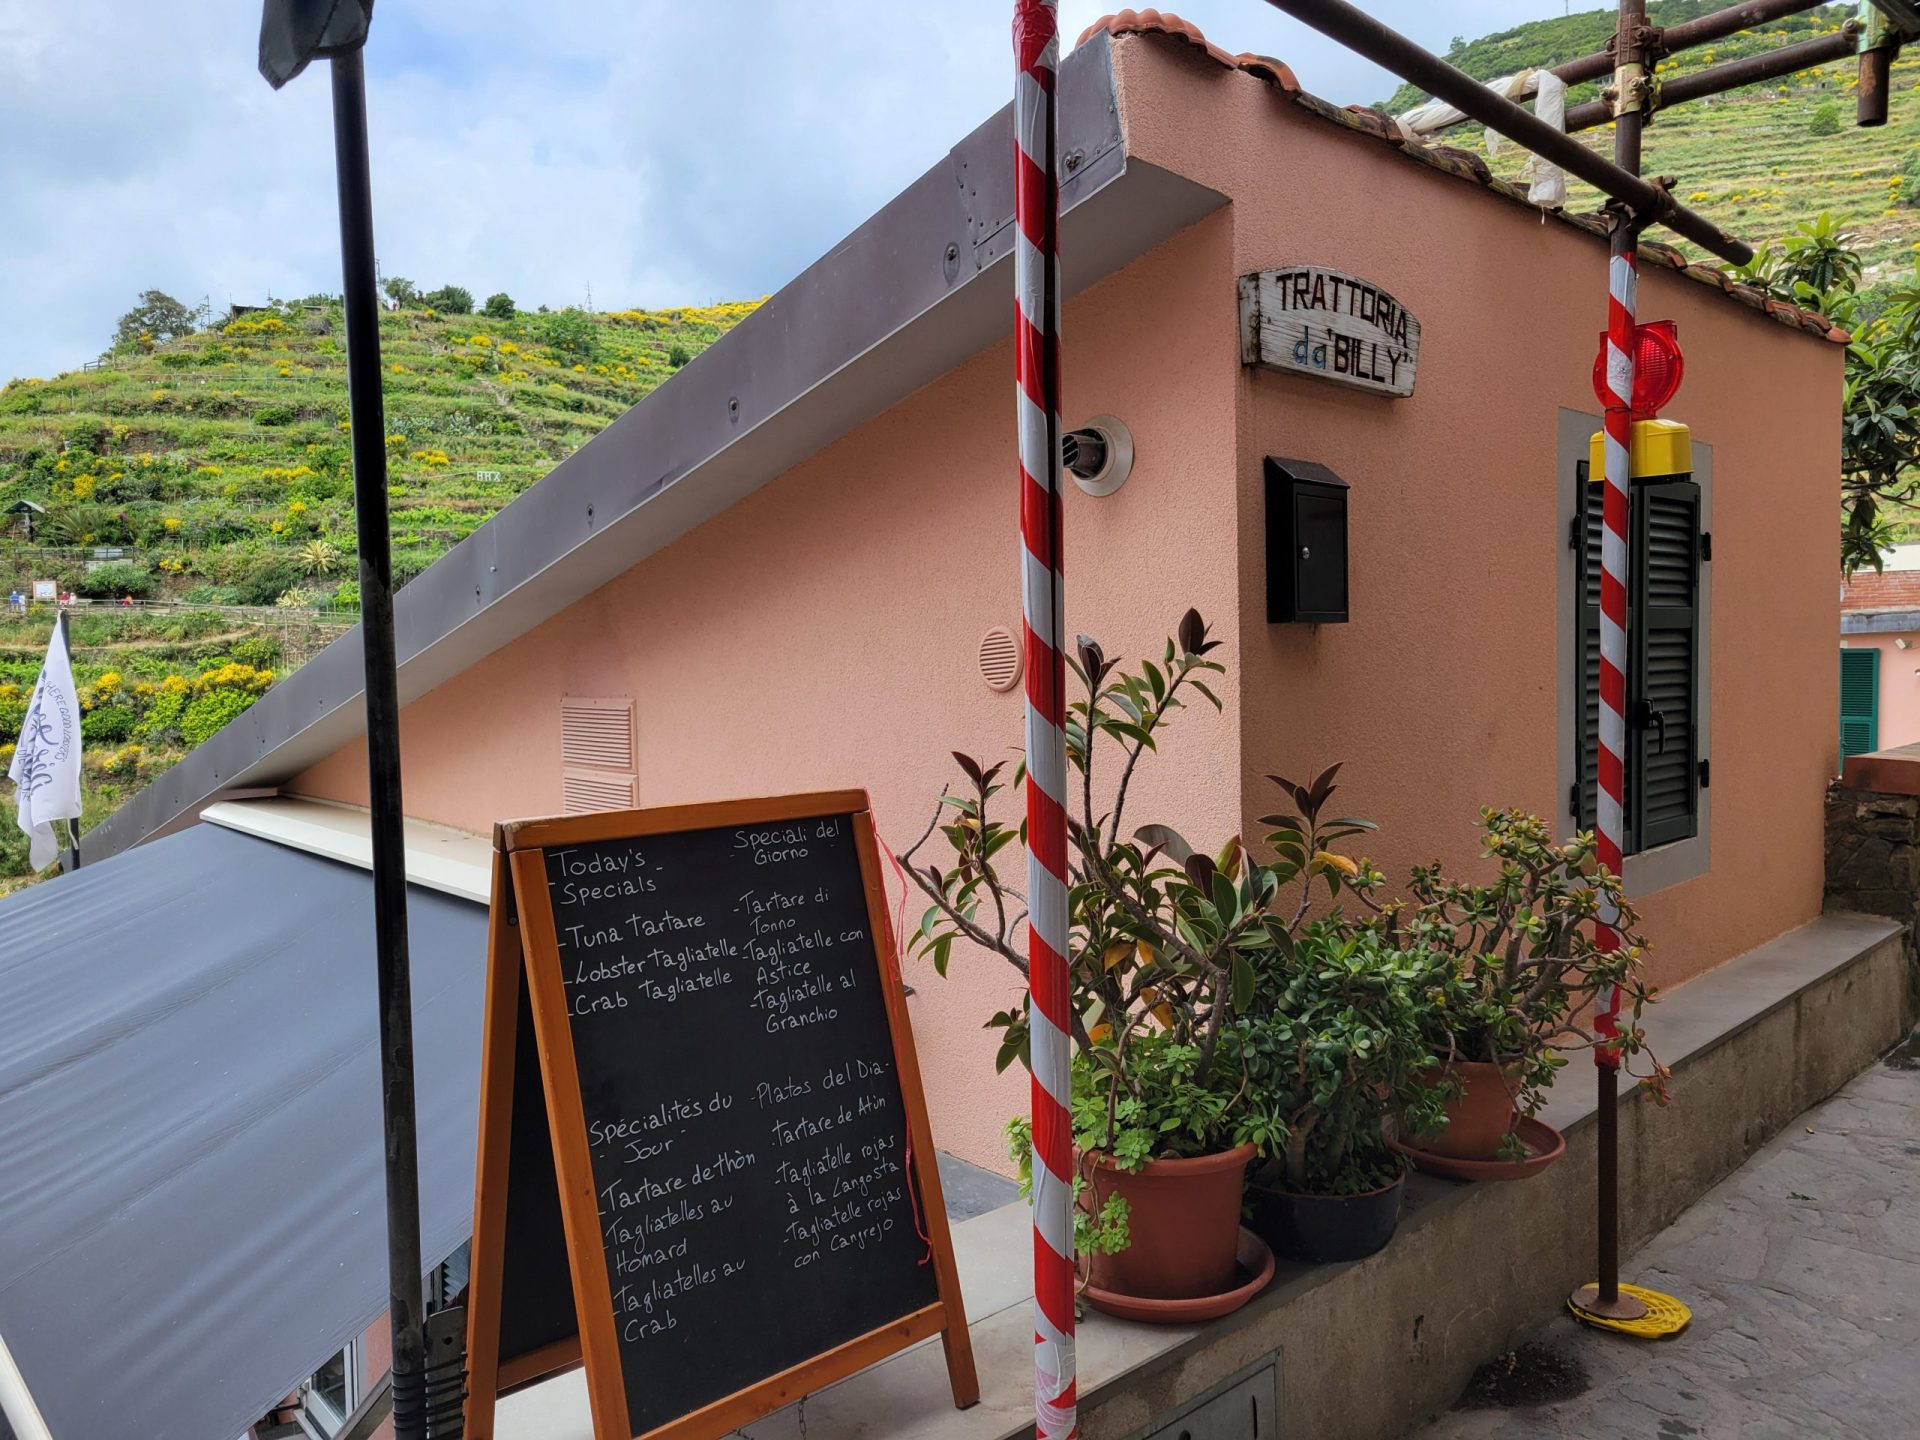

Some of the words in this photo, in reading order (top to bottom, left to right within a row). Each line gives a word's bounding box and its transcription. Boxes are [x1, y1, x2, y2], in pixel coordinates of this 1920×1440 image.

[1277, 270, 1409, 348] TRATTORIA
[1293, 325, 1327, 370] da
[734, 826, 807, 850] Speciali
[816, 818, 840, 839] del
[548, 849, 646, 877] Today's
[754, 848, 809, 865] Giorno
[814, 887, 829, 903] di
[625, 909, 706, 937] Tartare
[750, 915, 796, 936] Tonno
[839, 928, 864, 943] con
[647, 938, 739, 972] Tagliatelle
[638, 967, 733, 1002] Tagliatelle
[756, 960, 812, 986] Astice
[839, 968, 857, 989] al
[766, 1006, 838, 1033] Granchio
[822, 1062, 851, 1090] del
[708, 1091, 733, 1112] du
[837, 1104, 854, 1125] de
[624, 1138, 674, 1164] Jour
[861, 1135, 894, 1161] rojas
[691, 1163, 715, 1185] de
[808, 1186, 827, 1206] la
[833, 1156, 900, 1197] Langosta
[711, 1194, 733, 1214] au
[867, 1186, 901, 1212] rojas
[794, 1250, 821, 1268] con
[830, 1216, 894, 1251] Cangrejo
[616, 1237, 688, 1277] Homard
[722, 1258, 746, 1277] au
[624, 1309, 677, 1342] Crab
